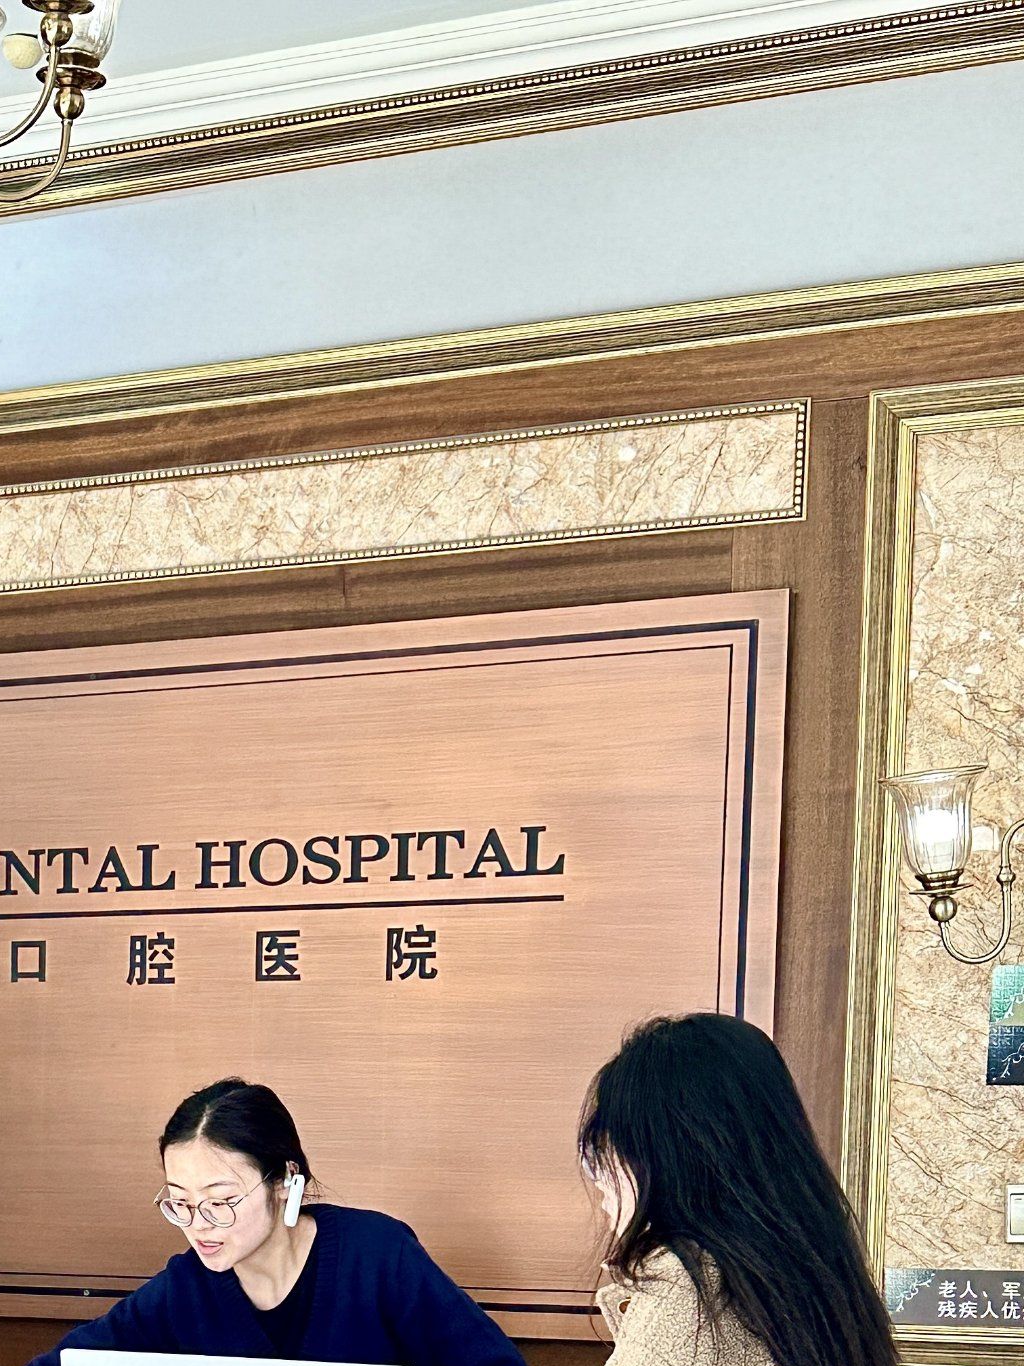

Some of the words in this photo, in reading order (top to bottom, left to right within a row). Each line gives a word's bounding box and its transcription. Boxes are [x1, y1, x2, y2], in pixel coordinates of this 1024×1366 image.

[195, 826, 564, 889] HOSPITAL
[938, 1280, 1024, 1300] 老人、军
[937, 1300, 1024, 1319] 残疾人优
